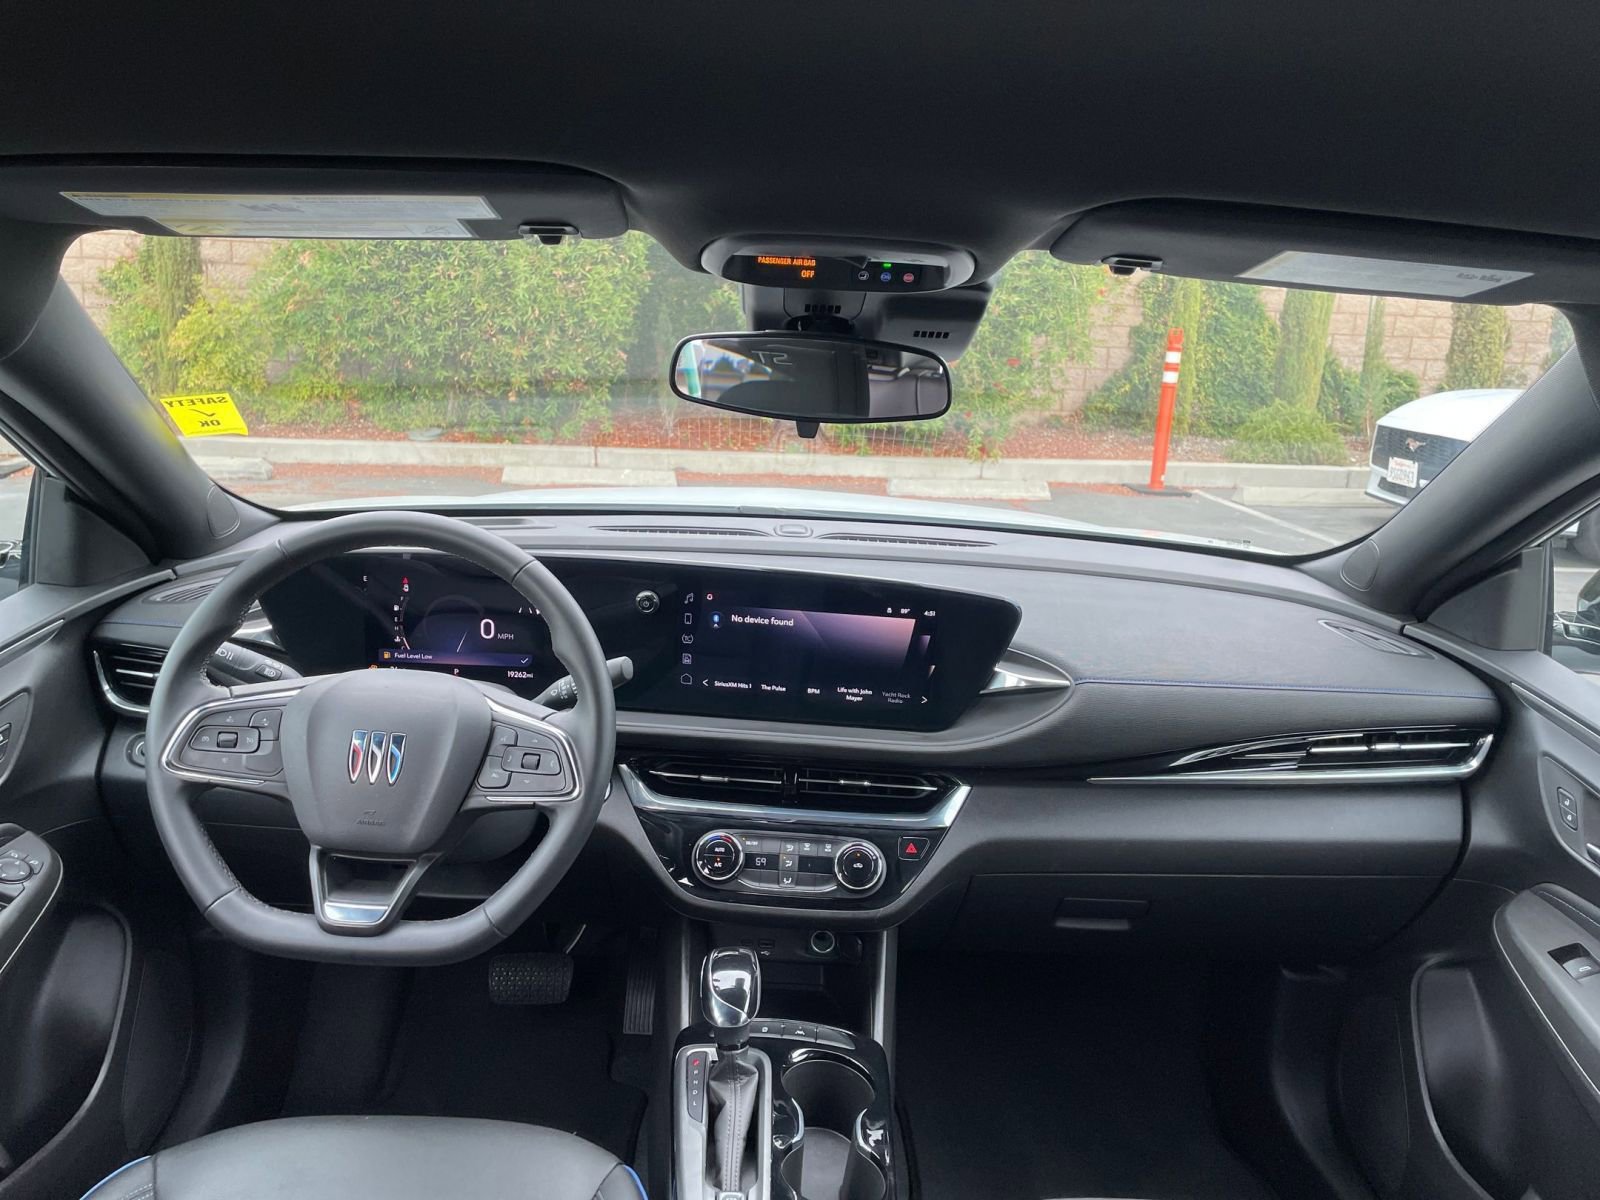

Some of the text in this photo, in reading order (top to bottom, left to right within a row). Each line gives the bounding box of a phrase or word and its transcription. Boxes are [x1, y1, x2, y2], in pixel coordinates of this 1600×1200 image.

[757, 256, 792, 265] PASSENGER
[793, 258, 803, 266] AIR
[801, 269, 815, 278] OFF
[731, 614, 794, 626] No device found
[480, 619, 495, 640] 0
[755, 857, 767, 866] 69
